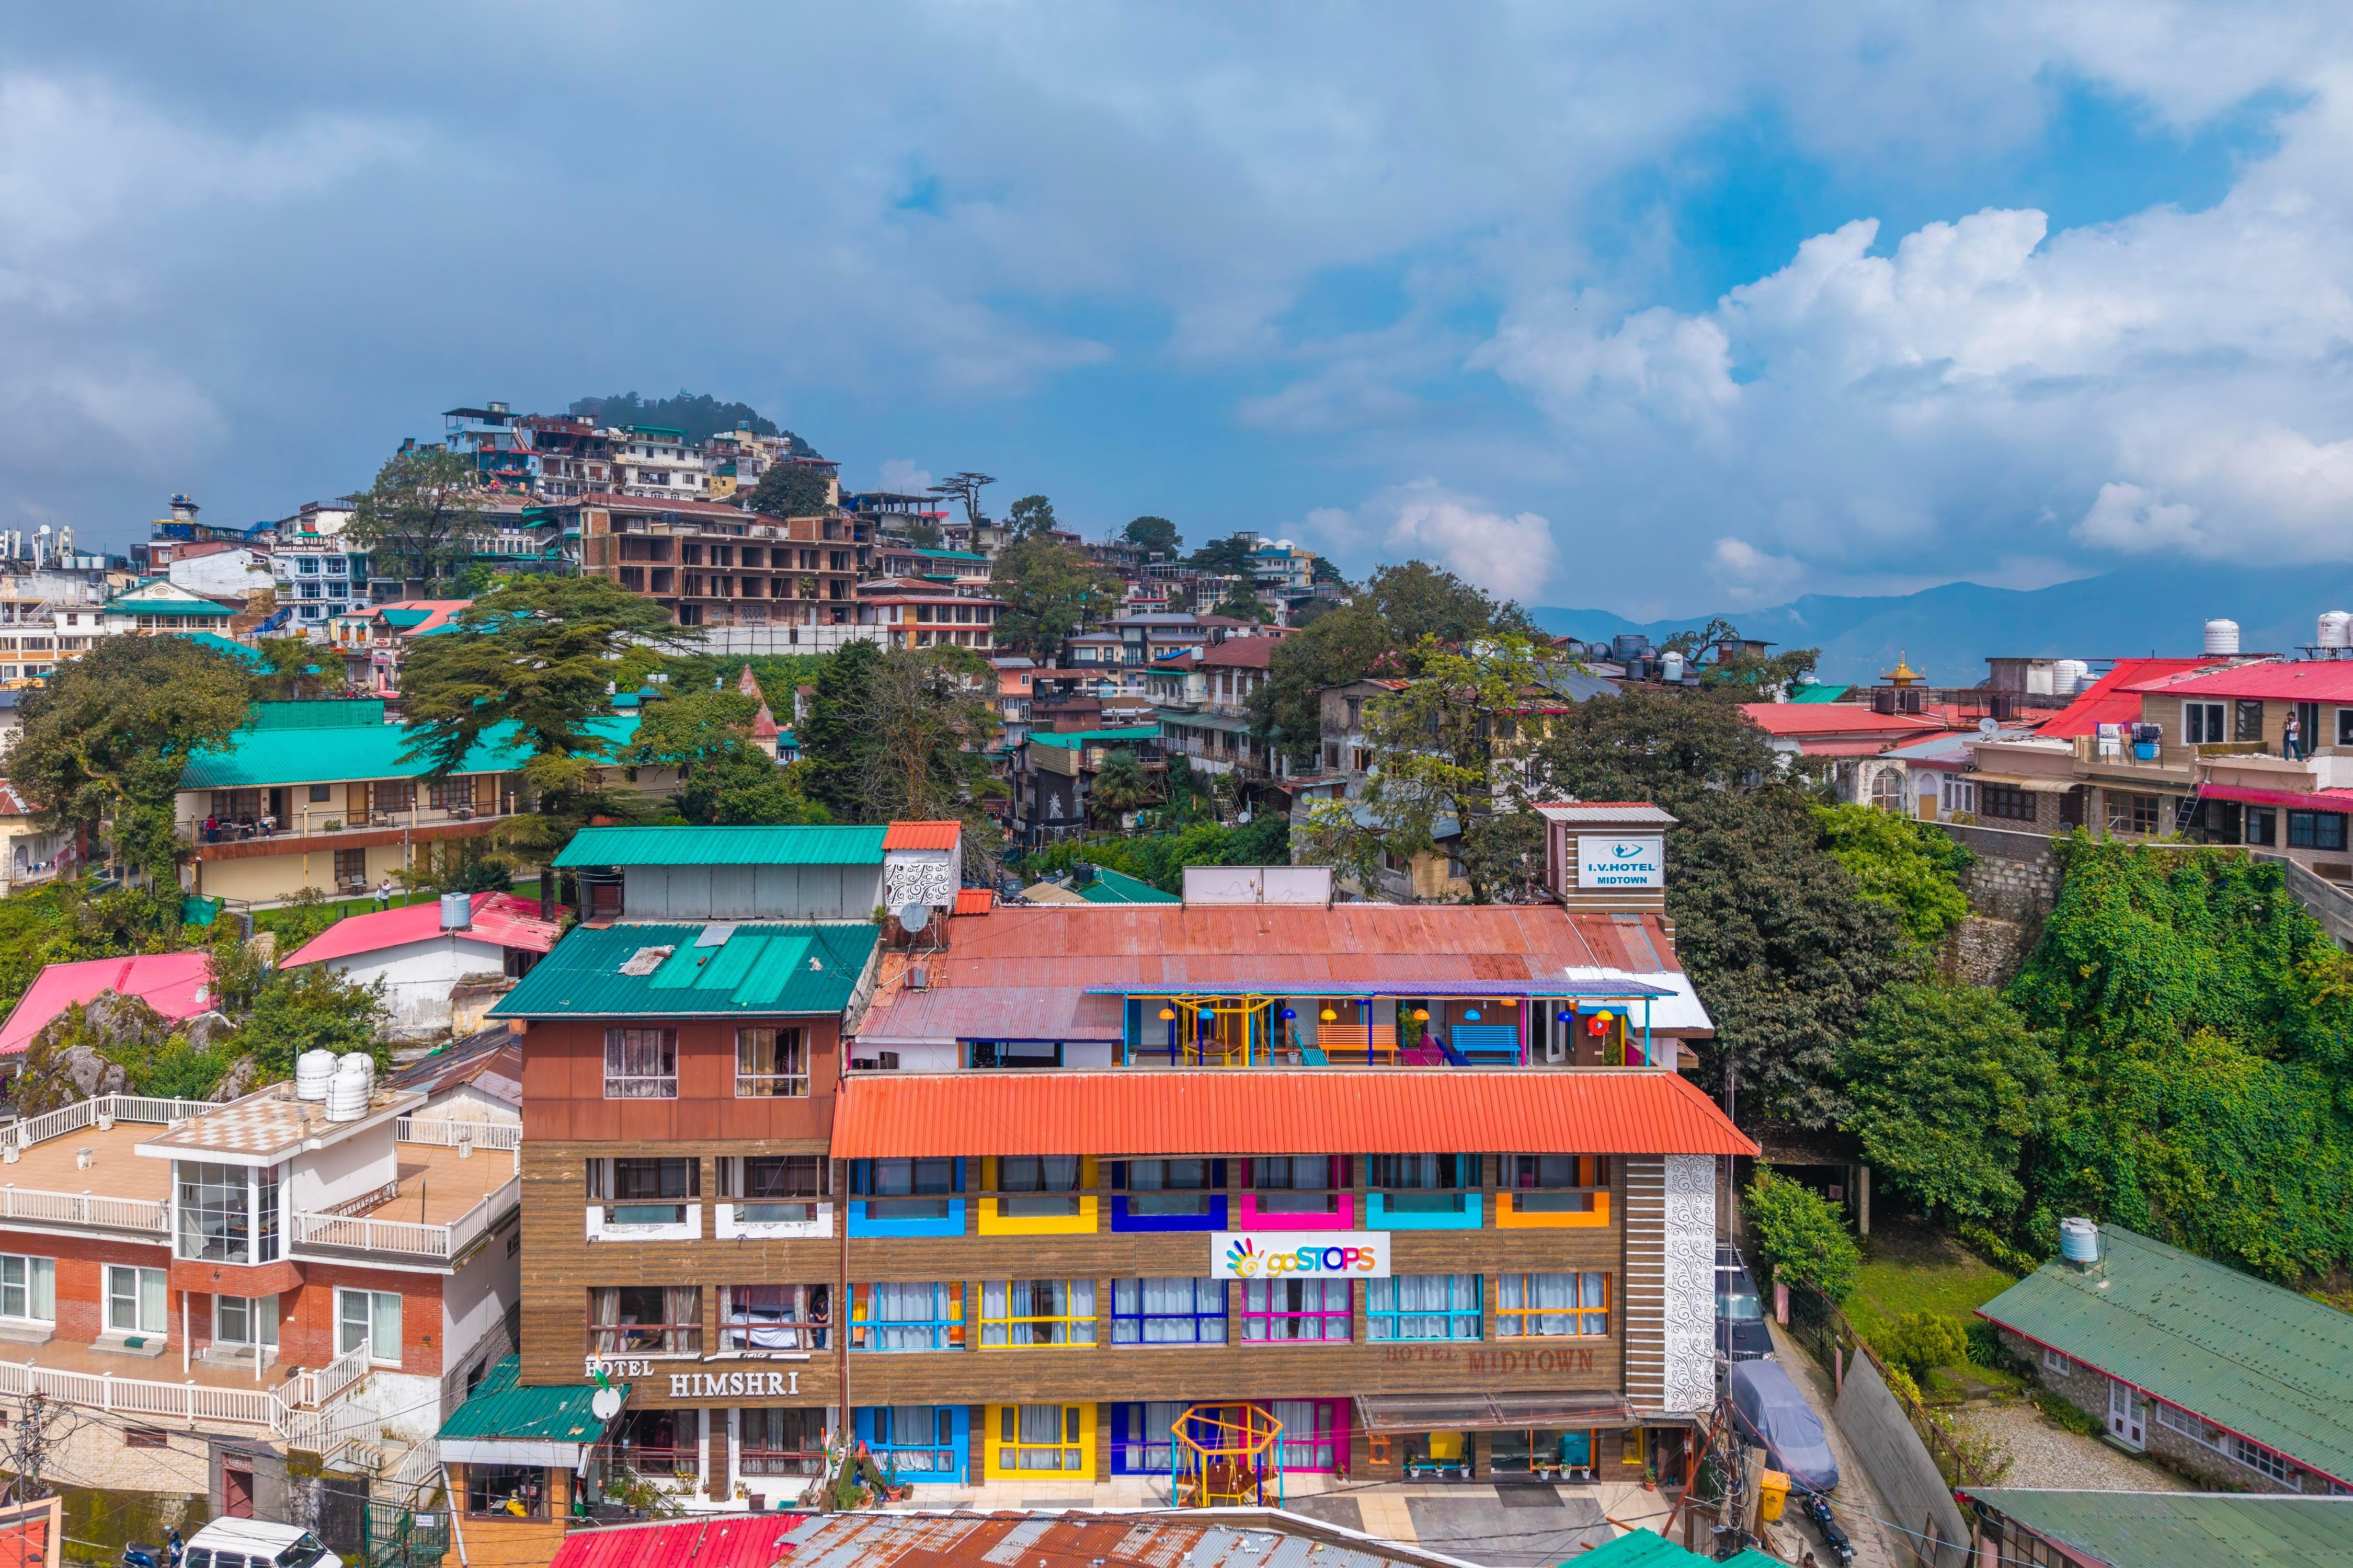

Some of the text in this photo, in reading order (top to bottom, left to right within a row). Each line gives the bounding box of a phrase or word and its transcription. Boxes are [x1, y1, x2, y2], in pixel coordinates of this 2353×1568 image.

[1589, 863, 1655, 872] I.V.HOTEL
[1266, 1246, 1376, 1277] goSTOPS
[1385, 1345, 1594, 1374] HOTEL MIDTOWN
[585, 1360, 798, 1397] HOTEL HIMSHRI
